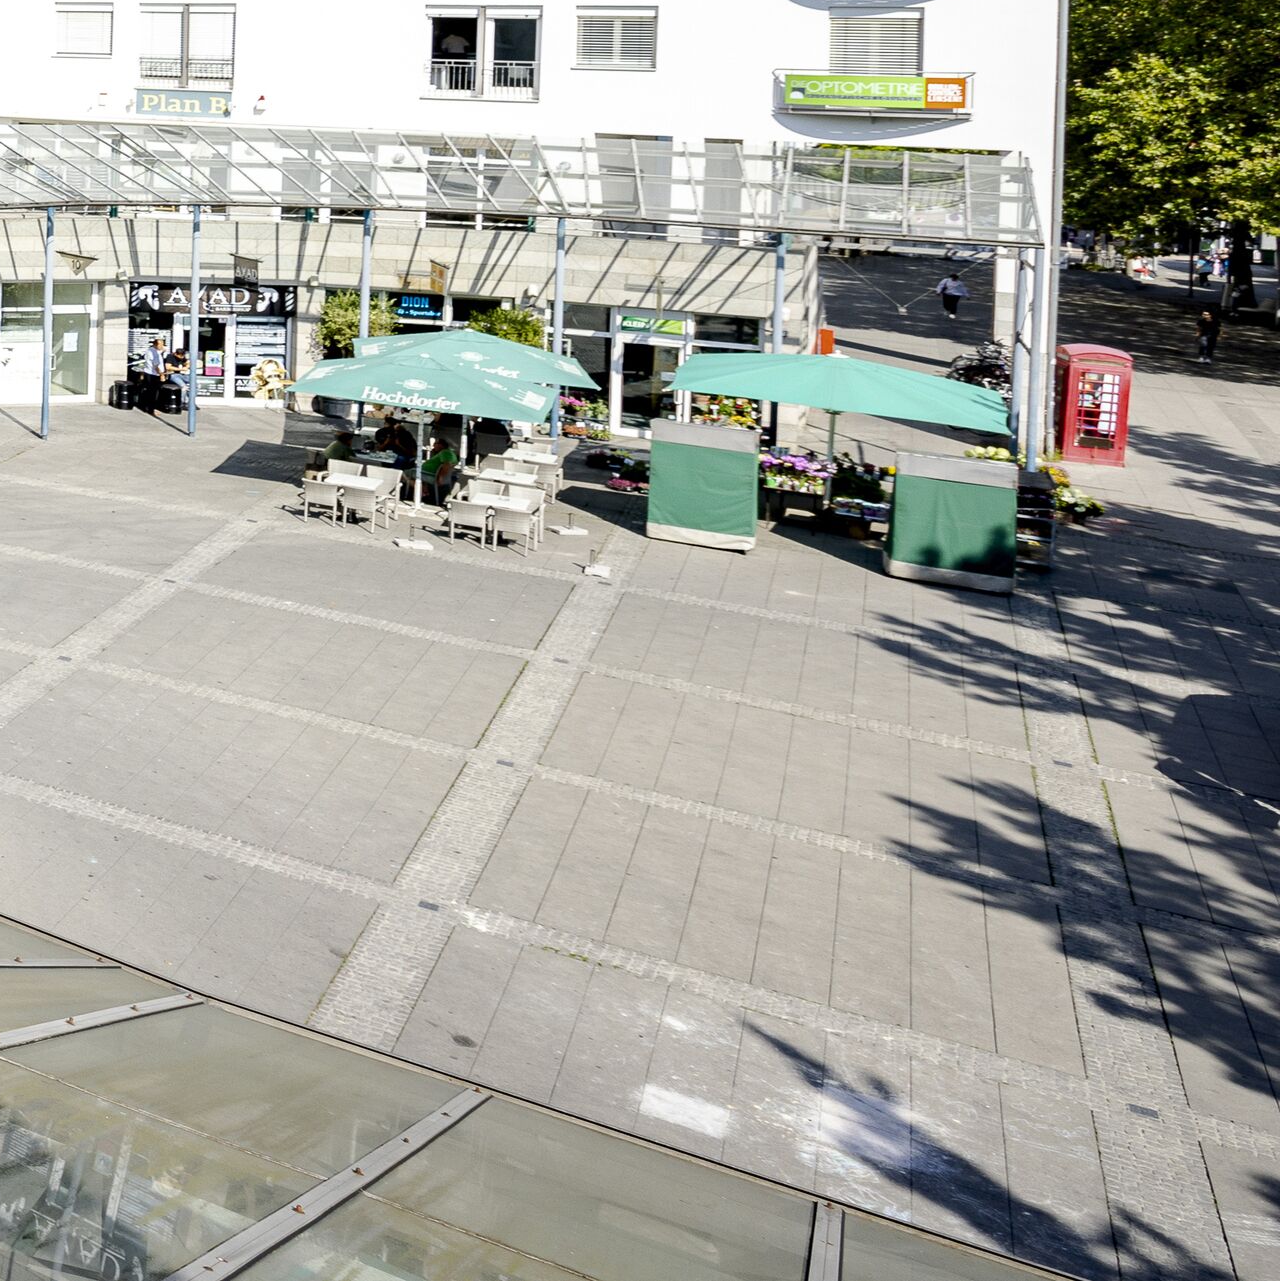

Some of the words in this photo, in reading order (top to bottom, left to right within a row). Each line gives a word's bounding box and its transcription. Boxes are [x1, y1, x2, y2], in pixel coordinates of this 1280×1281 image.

[807, 80, 923, 96] OPTOMETRIE
[142, 94, 202, 113] Plan
[208, 97, 228, 114] B
[71, 260, 82, 270] 10
[401, 296, 429, 308] DION
[361, 385, 461, 412] Hochdorfer
